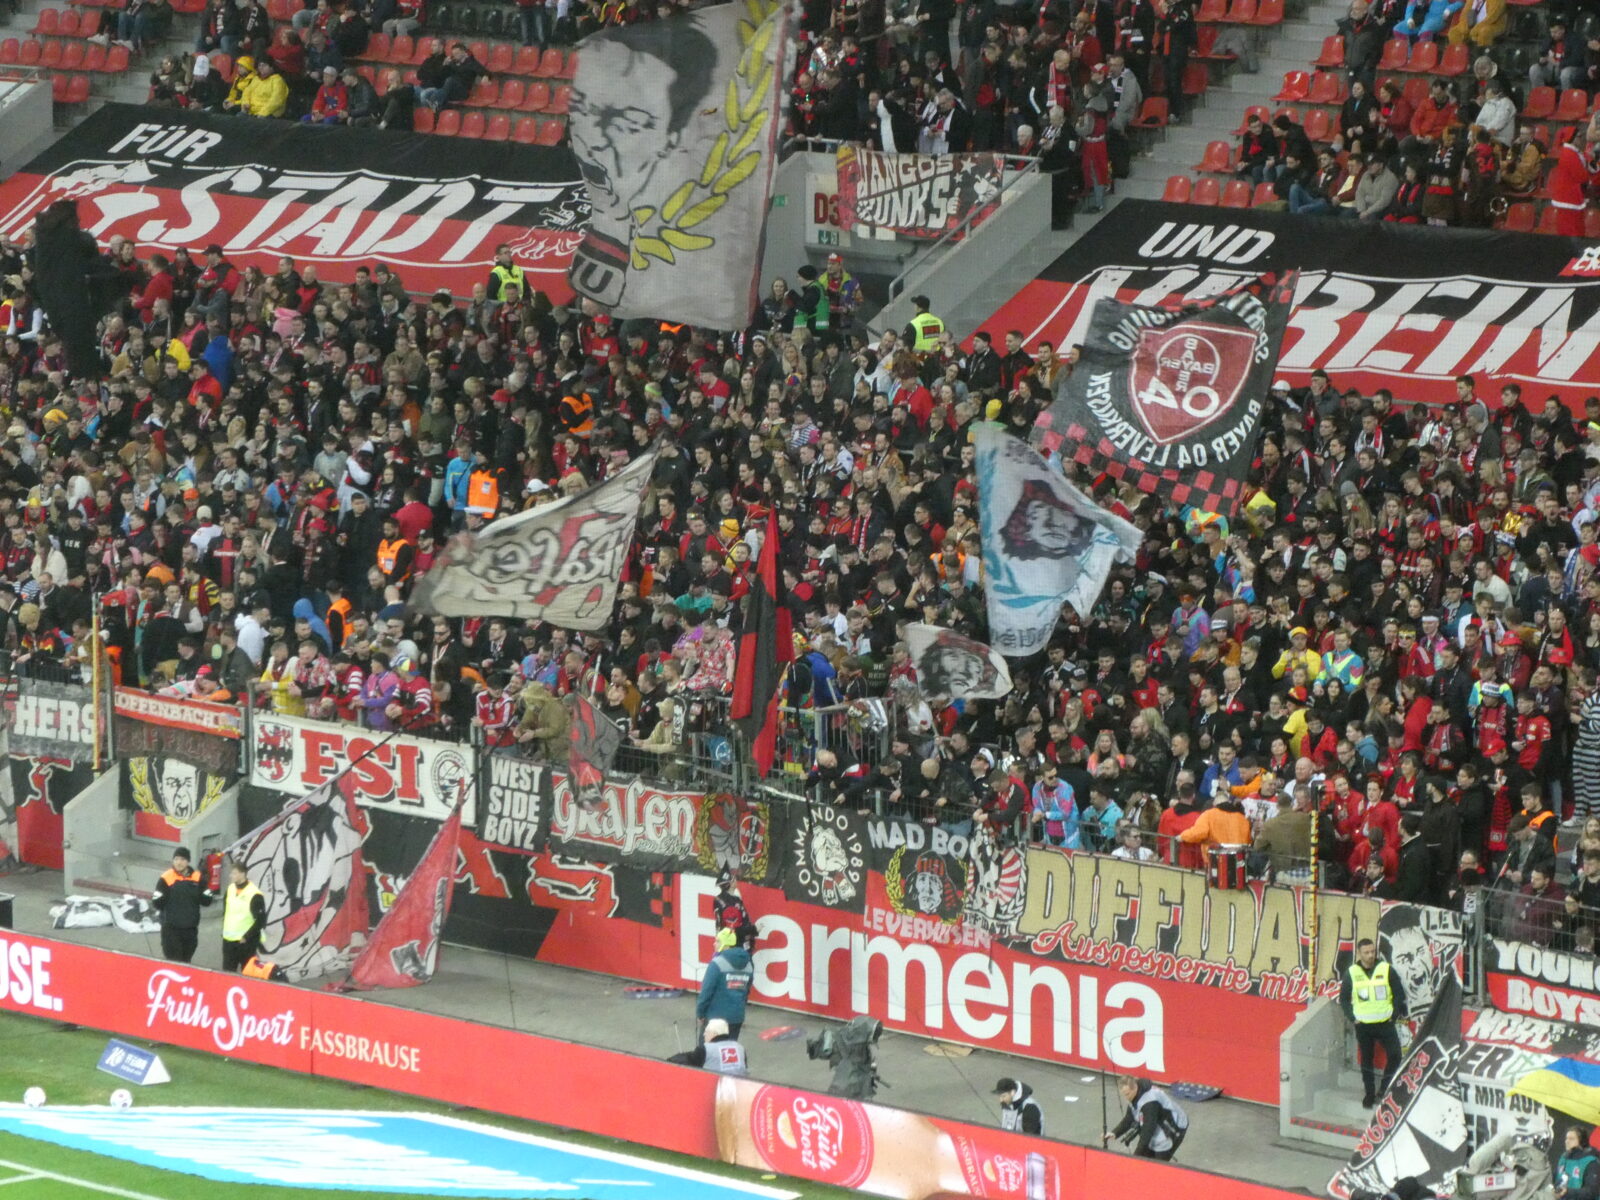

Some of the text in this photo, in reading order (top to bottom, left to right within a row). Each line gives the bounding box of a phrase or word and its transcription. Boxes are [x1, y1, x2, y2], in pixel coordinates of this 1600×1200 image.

[107, 122, 223, 162] FÜR
[137, 166, 551, 262] STADT
[1138, 222, 1277, 265] UND
[491, 756, 543, 793] WEST
[488, 785, 541, 823] SIDE
[484, 814, 538, 850] BOYZ
[868, 821, 925, 850] MAD
[864, 904, 991, 949] LEVERKUSEN
[1018, 847, 1382, 983] DIFFIDATI
[146, 969, 421, 1073] Früh Sport FASSBRAUSE
[1474, 1085, 1506, 1110] MIR
